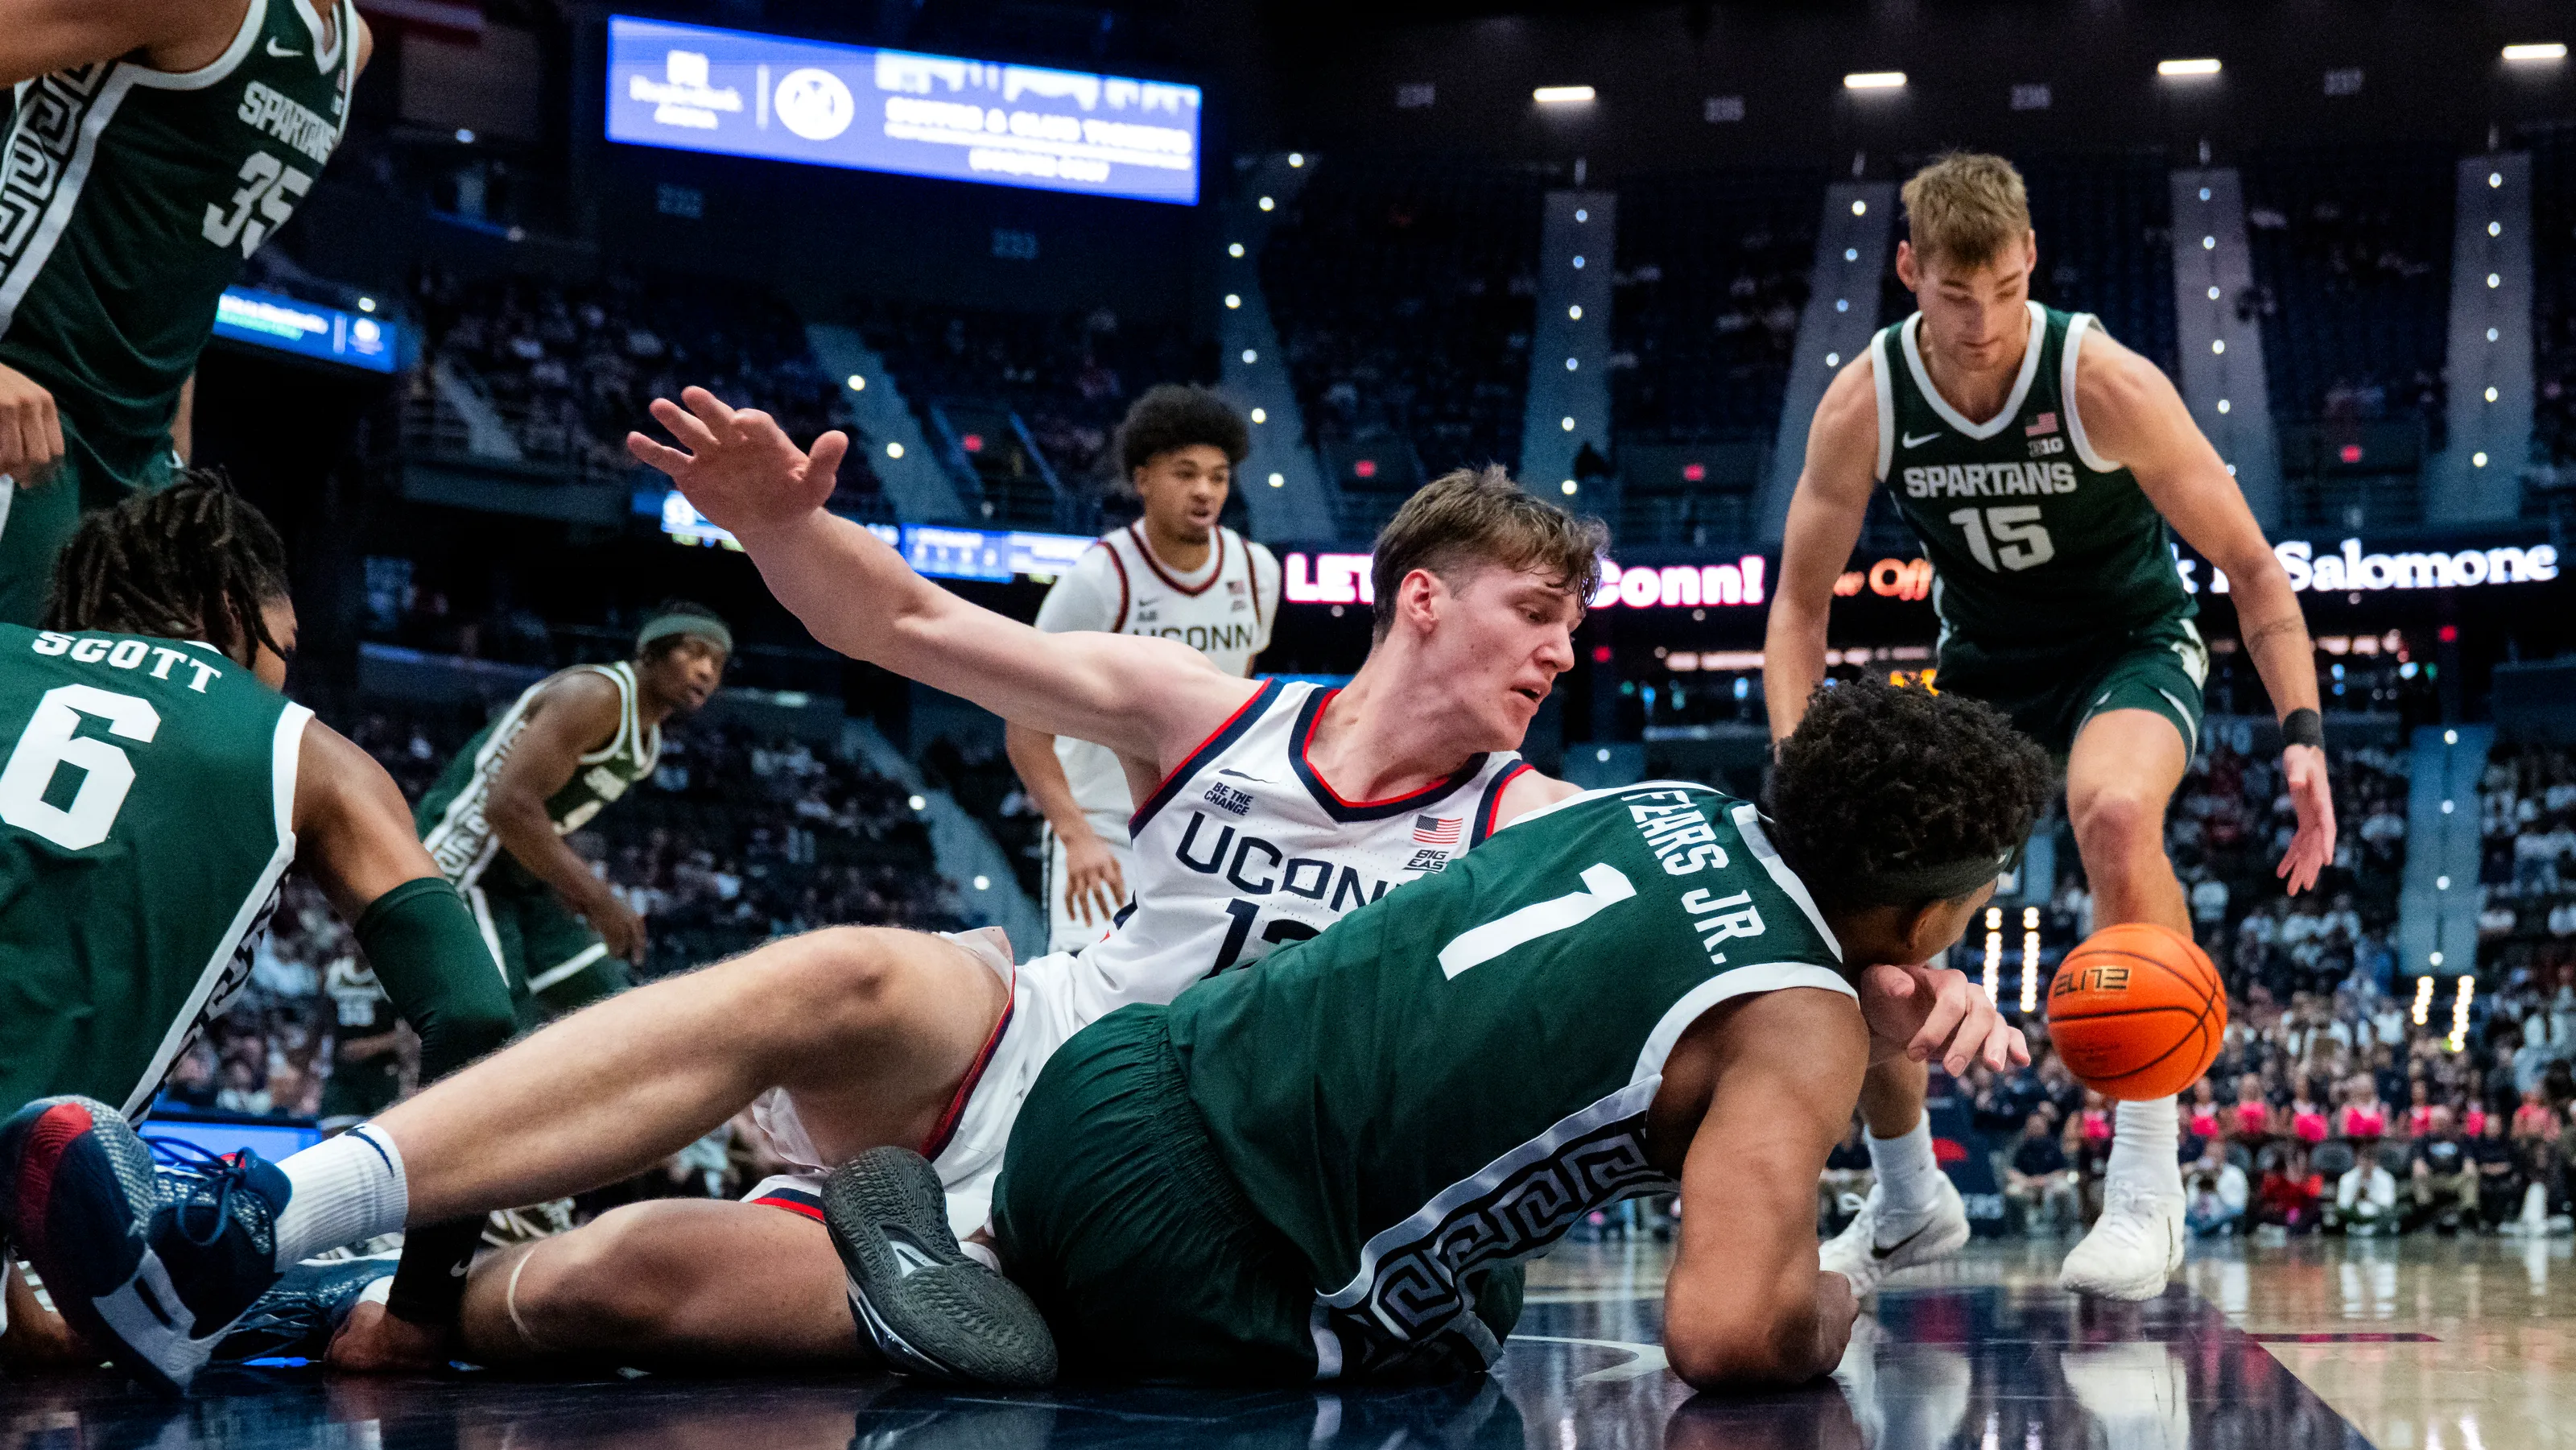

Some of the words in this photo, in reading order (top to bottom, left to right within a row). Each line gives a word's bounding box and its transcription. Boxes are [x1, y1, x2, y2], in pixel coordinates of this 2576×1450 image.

[202, 151, 313, 259] 35
[1903, 461, 2078, 498] SPARTANS
[1949, 505, 2055, 572] 15
[2273, 538, 2559, 592] Salomone
[31, 631, 222, 693] SCOTT
[0, 683, 162, 851] 6
[1213, 781, 1231, 796] BE
[1230, 789, 1254, 806] THE
[1203, 790, 1250, 816] CHANGE
[1175, 811, 1405, 912] UCON
[1407, 858, 1448, 870] EAS
[1414, 849, 1449, 861] BIG
[1437, 862, 1637, 981] 1
[1681, 886, 1766, 965] JR.
